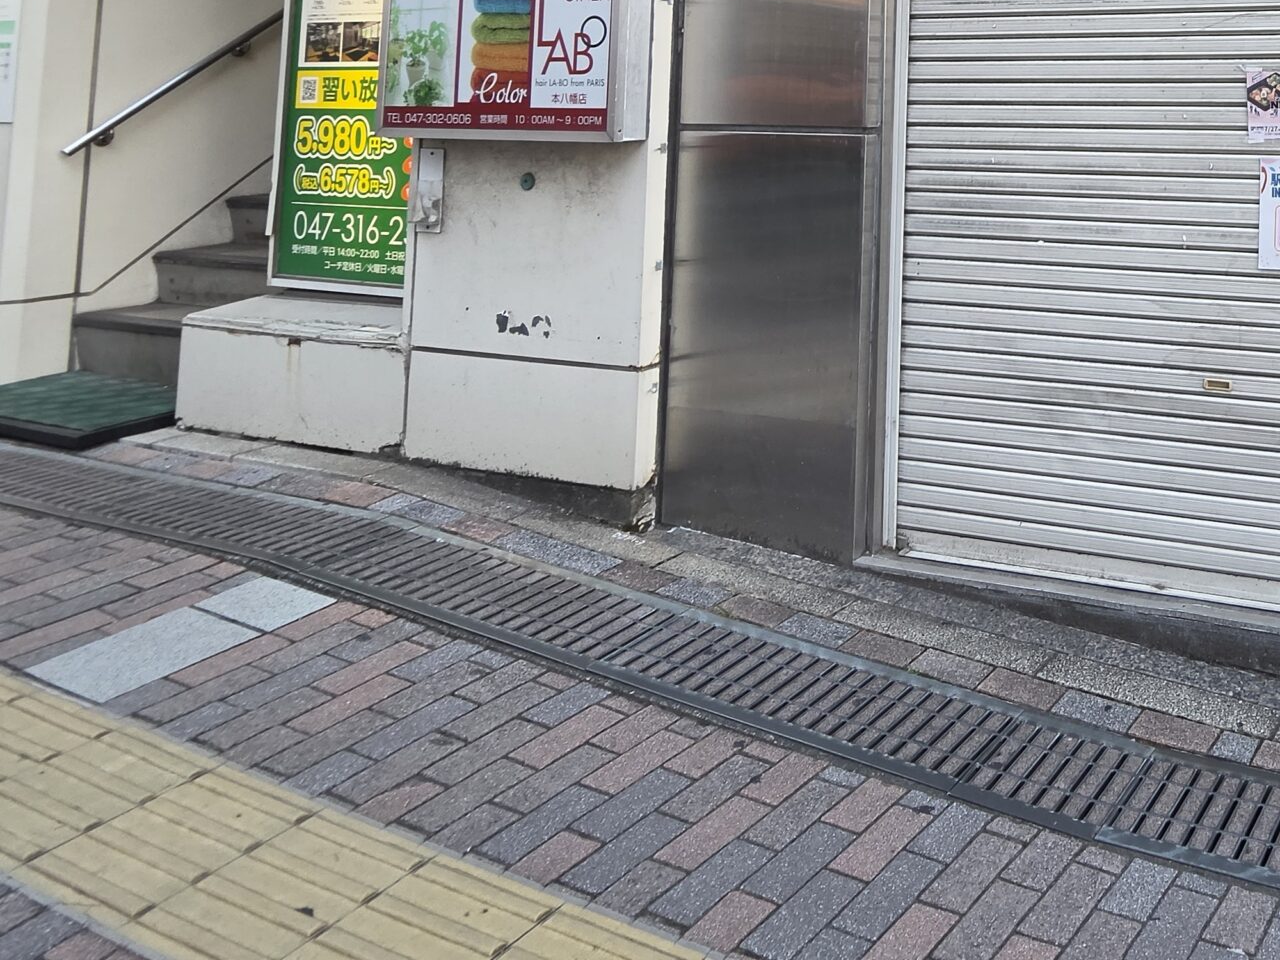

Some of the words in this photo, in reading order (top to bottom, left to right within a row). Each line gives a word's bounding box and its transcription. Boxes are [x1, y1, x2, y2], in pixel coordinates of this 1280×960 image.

[474, 72, 527, 104] Color
[535, 78, 547, 86] hair
[570, 78, 584, 86] from
[587, 78, 605, 87] PARIS
[322, 76, 377, 103] 習い放
[551, 93, 587, 104] 本八幡店
[387, 113, 402, 123] TEL
[404, 113, 472, 125] 047-302-0606
[480, 115, 508, 125] 営業時間
[294, 211, 408, 246] 047-316-2
